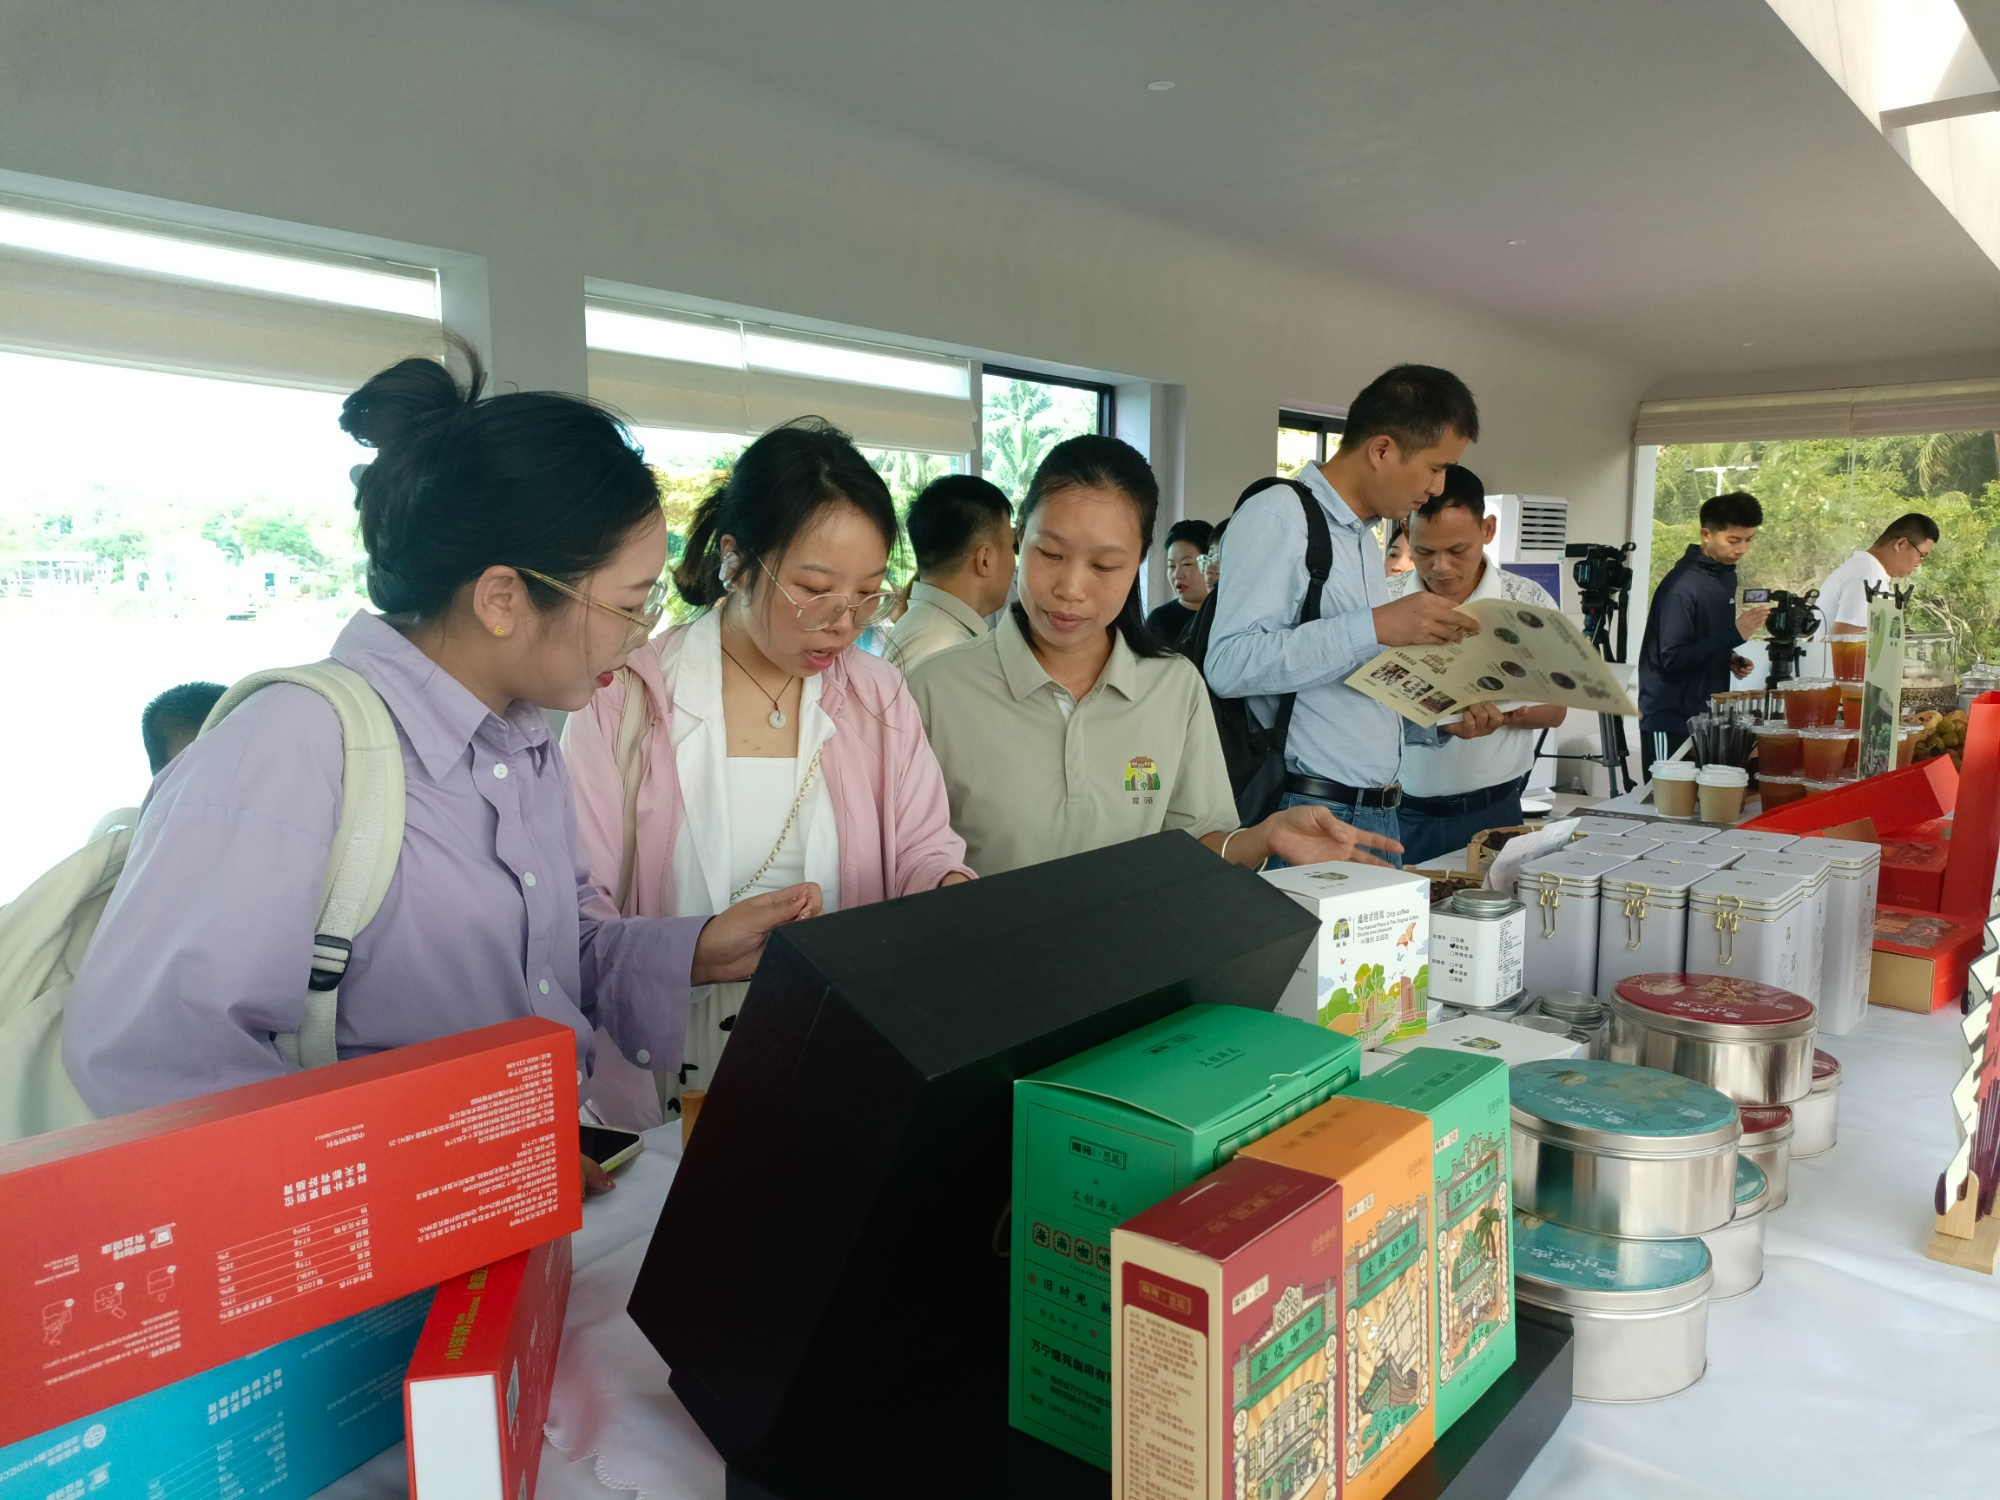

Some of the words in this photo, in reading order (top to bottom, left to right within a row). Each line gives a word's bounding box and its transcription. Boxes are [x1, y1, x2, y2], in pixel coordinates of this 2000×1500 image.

[283, 1160, 365, 1196] 每天都有好肠胃
[284, 1172, 366, 1207] 科学补菌更到位
[100, 1232, 144, 1255] 有益健康
[338, 1270, 372, 1289] 营养成分表
[1043, 1278, 1087, 1307] 旧时光
